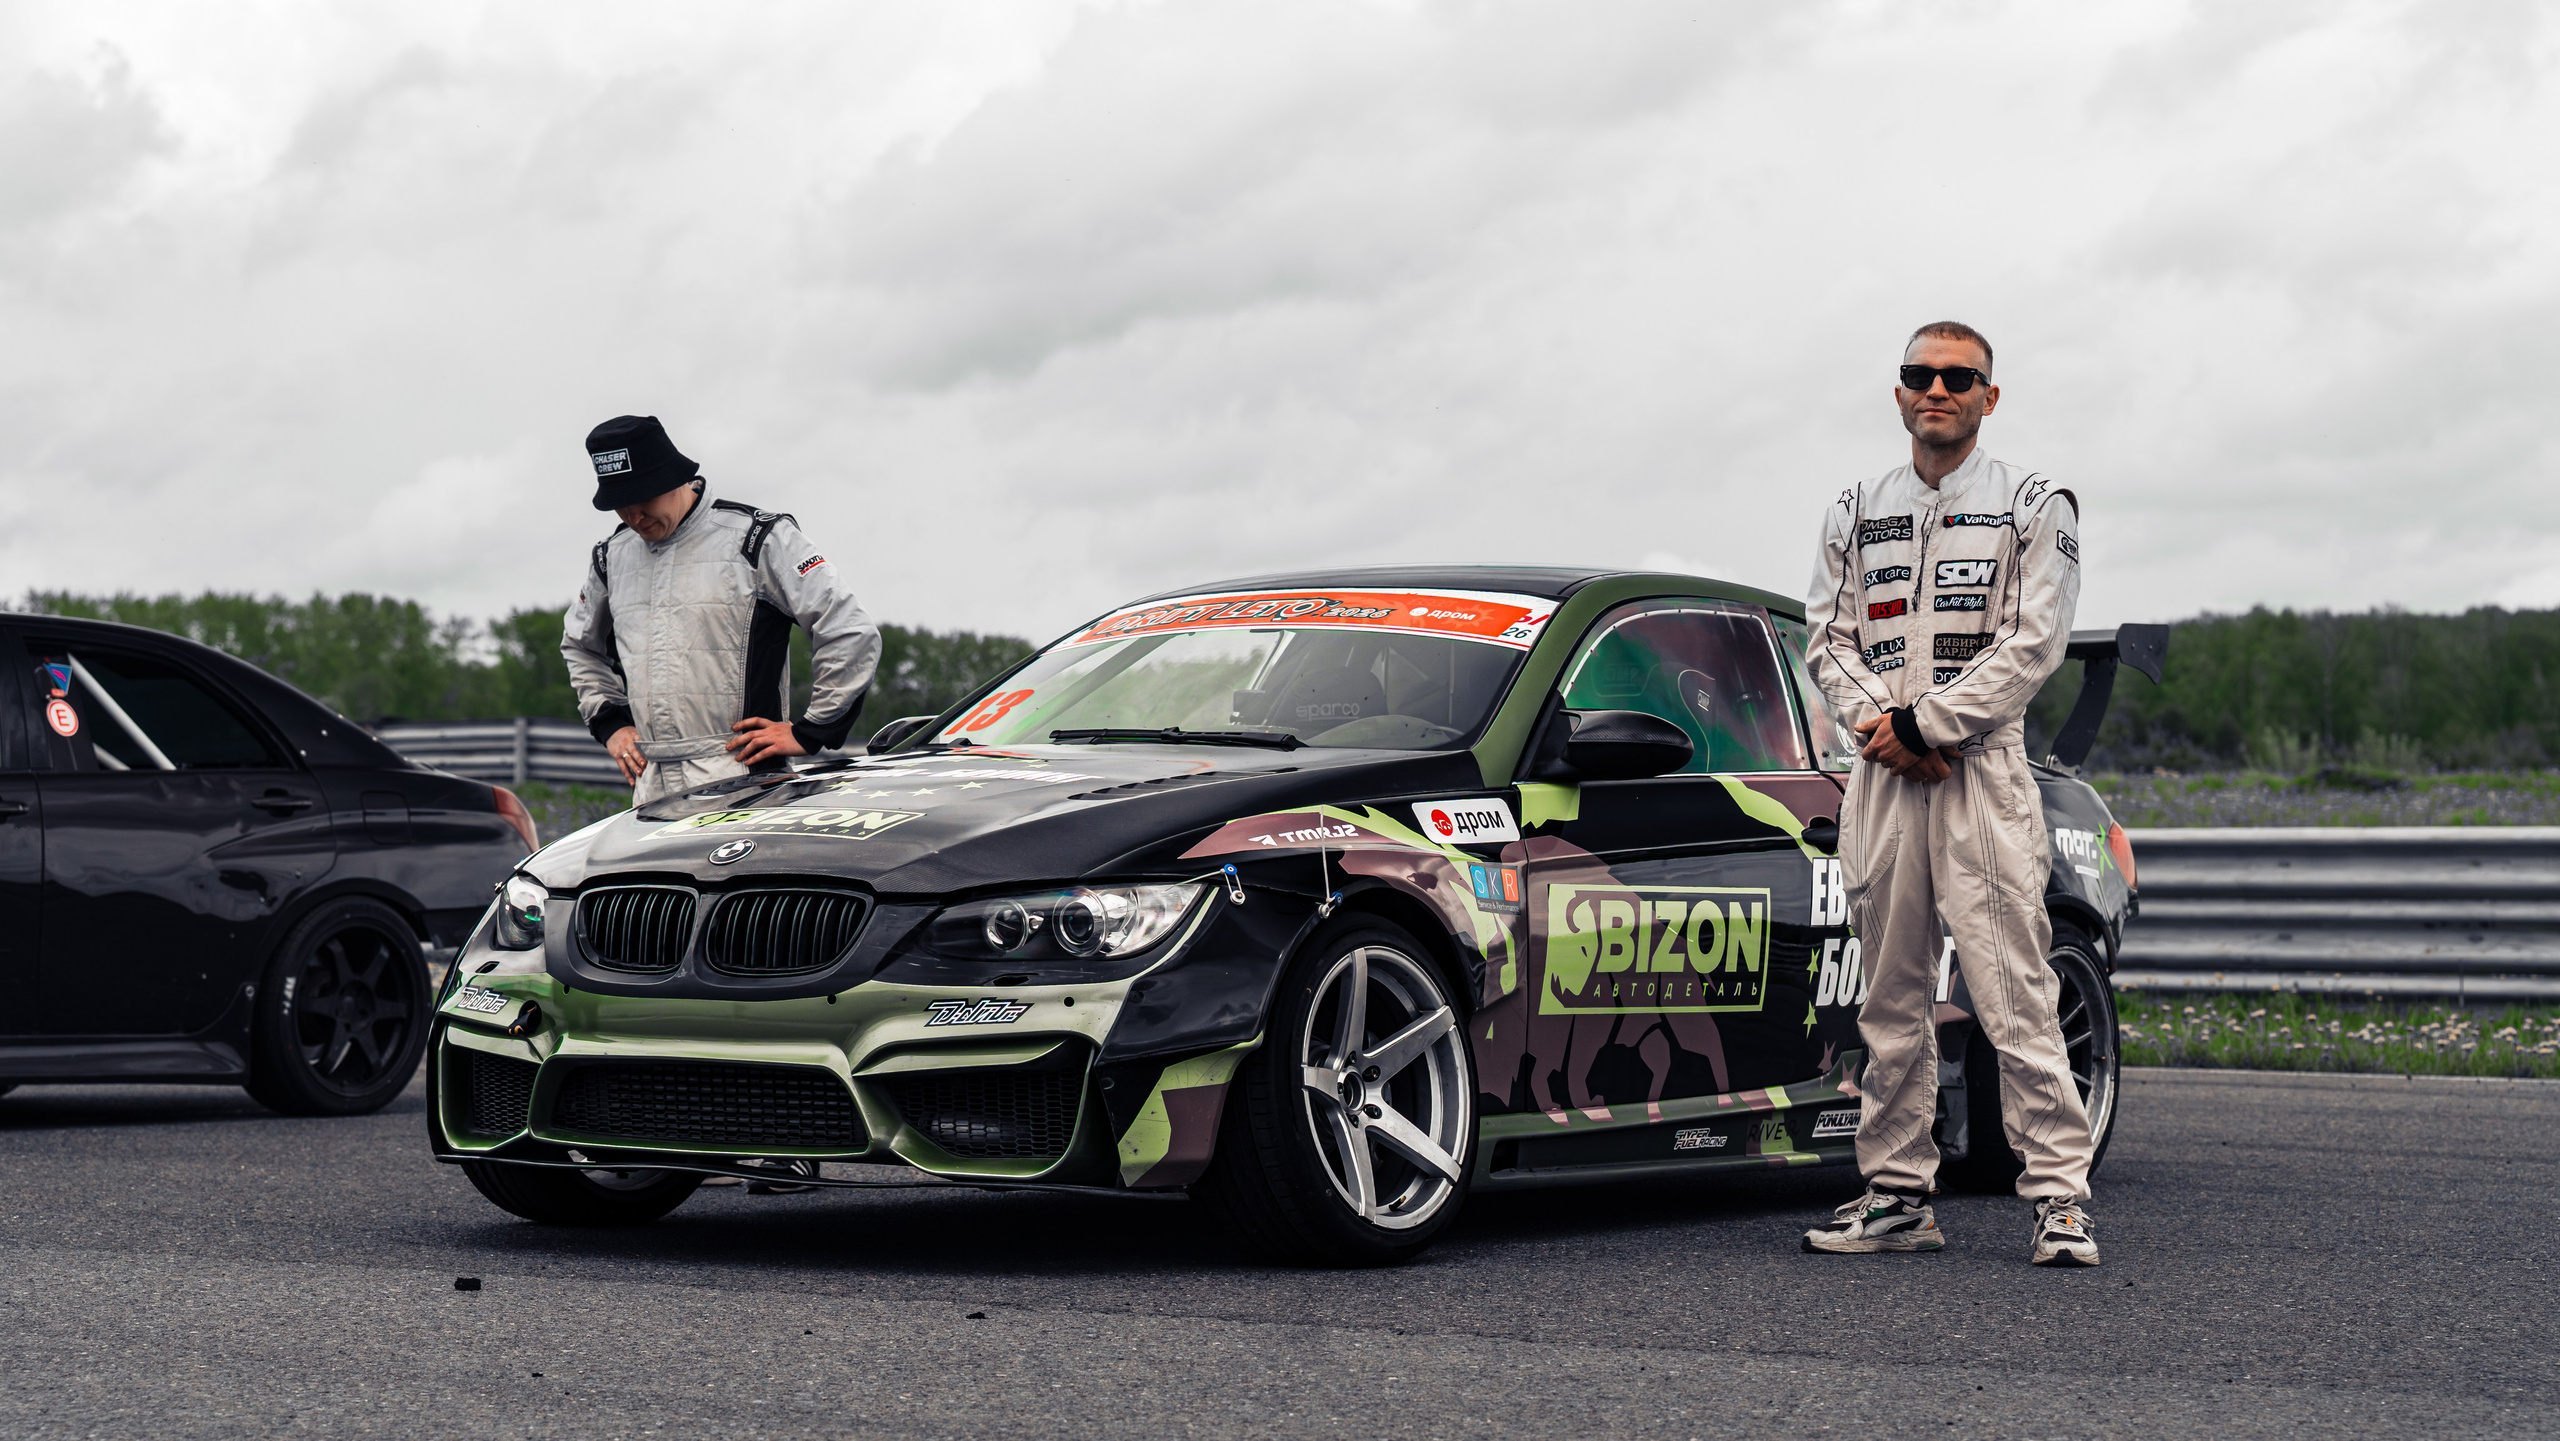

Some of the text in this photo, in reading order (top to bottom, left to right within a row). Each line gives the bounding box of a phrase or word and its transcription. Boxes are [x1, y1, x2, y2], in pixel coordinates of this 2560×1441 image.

[595, 452, 626, 464] CHASER
[598, 461, 623, 472] CREW
[1860, 528, 1912, 542] OTORS
[1885, 568, 1909, 580] care
[1938, 561, 1997, 586] SCW
[1428, 608, 1476, 621] дром
[944, 689, 1035, 736] 13
[1296, 703, 1360, 721] sparco
[712, 809, 910, 830] BIZON
[1453, 810, 1505, 836] дром
[1596, 900, 1763, 974] BIZON
[1594, 982, 1758, 999] АВТОДЕТАЛЬ
